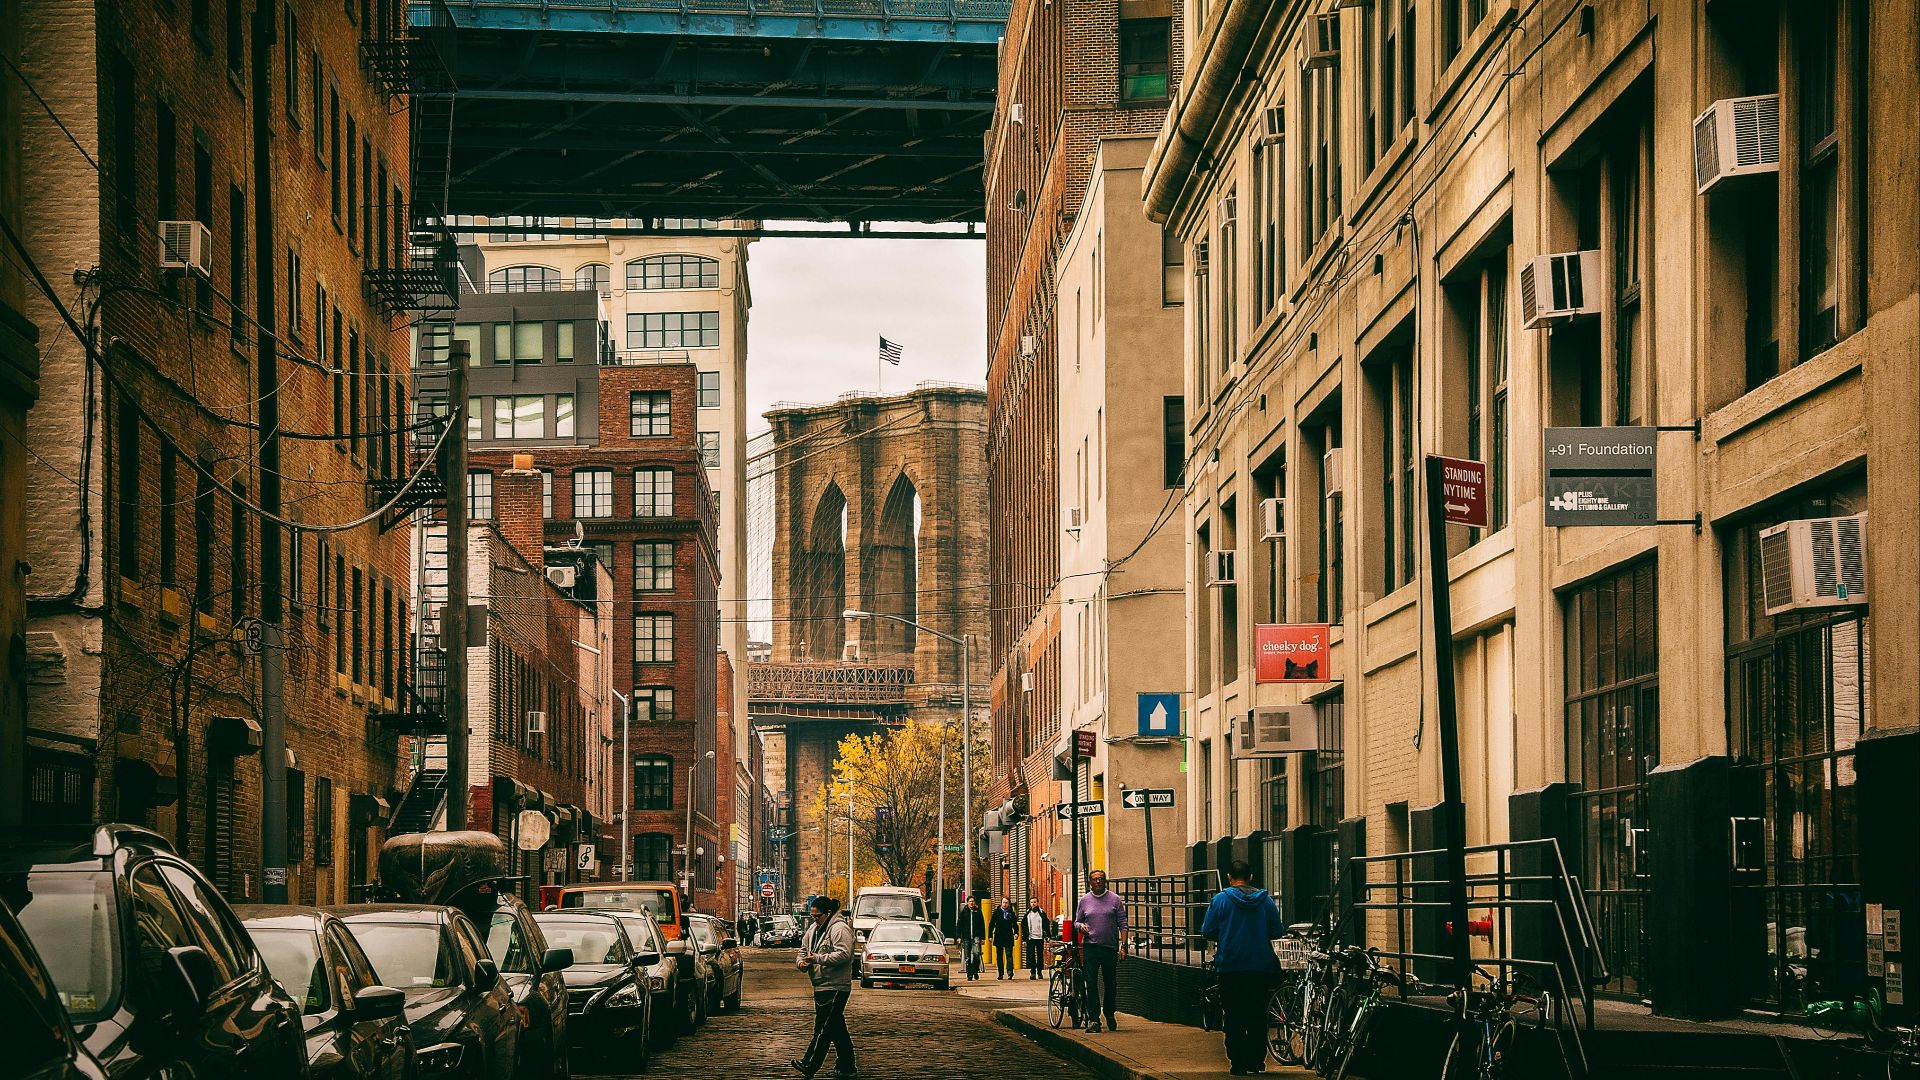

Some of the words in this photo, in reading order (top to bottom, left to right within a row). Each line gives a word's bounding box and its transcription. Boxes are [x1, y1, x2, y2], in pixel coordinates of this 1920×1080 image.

[1549, 443, 1573, 456] +91
[1578, 443, 1653, 456] Foundation
[1444, 466, 1482, 484] STANDING
[1443, 482, 1477, 500] NYTIME
[1603, 503, 1629, 511] GALLERY
[1633, 512, 1650, 520] 163
[1263, 640, 1298, 652] cheeky
[1300, 637, 1319, 652] dog
[1135, 795, 1145, 804] ON
[1152, 794, 1169, 802] WAY
[1083, 804, 1098, 812] WAY
